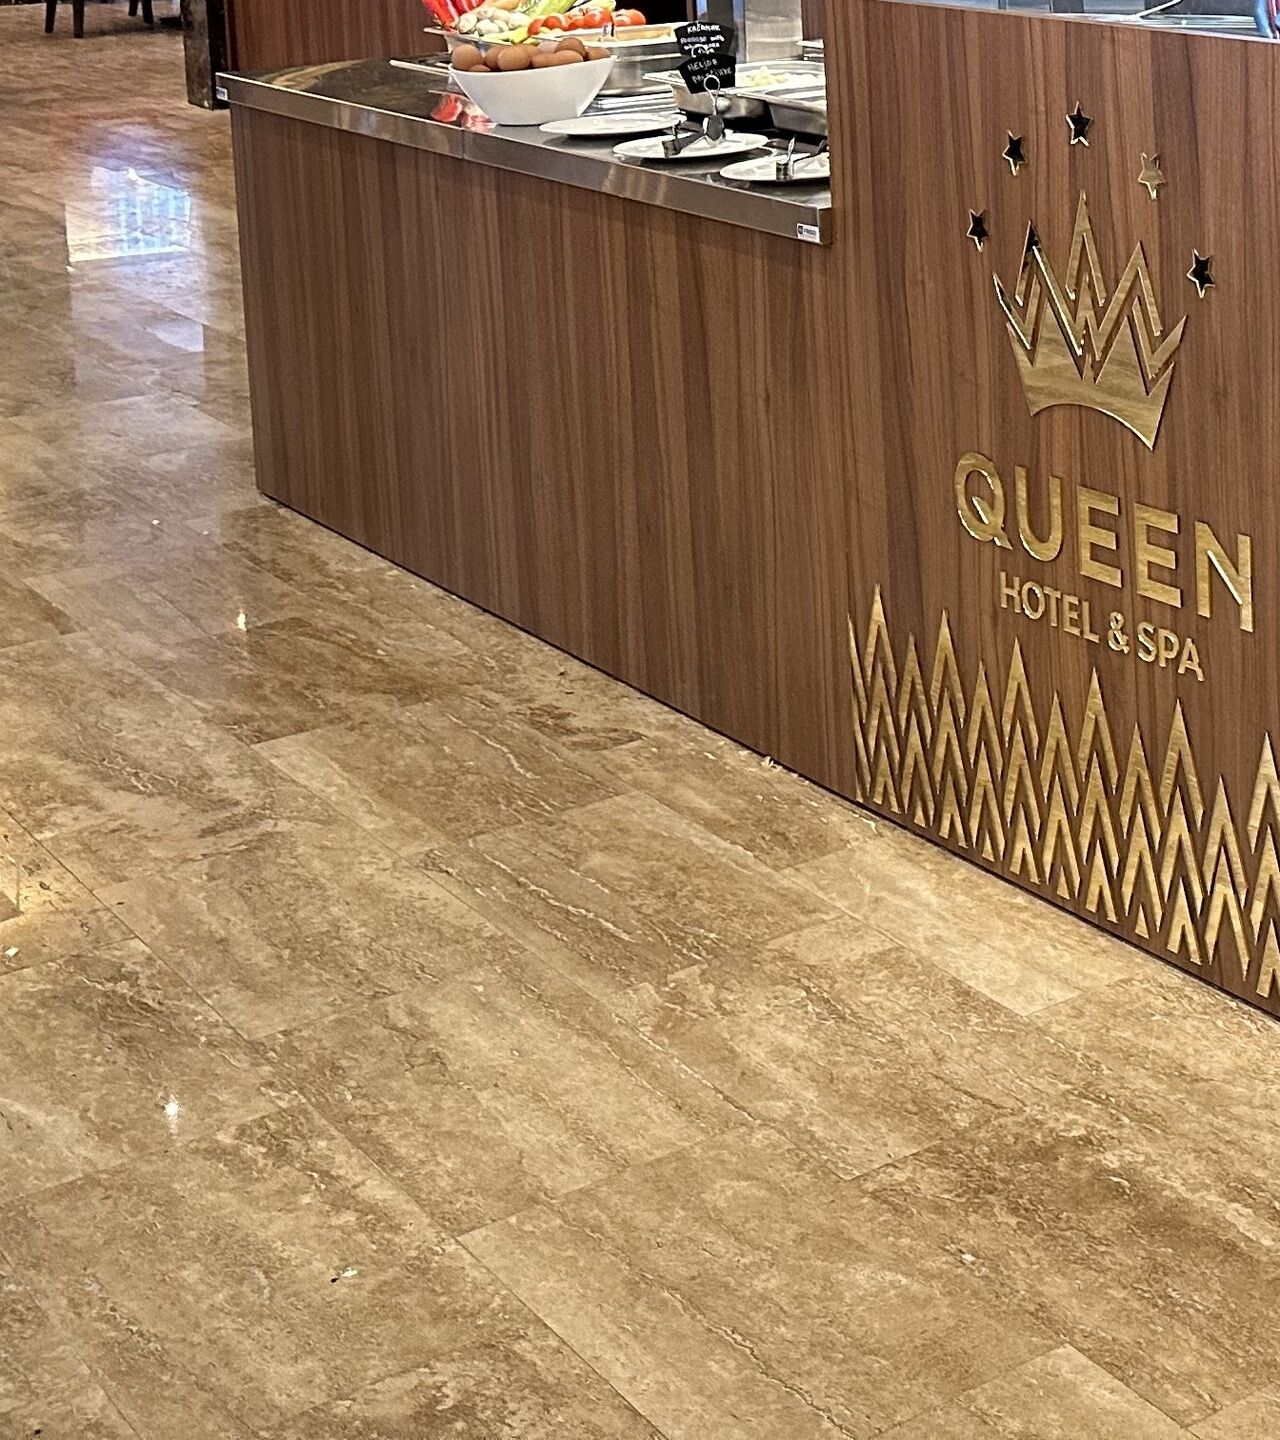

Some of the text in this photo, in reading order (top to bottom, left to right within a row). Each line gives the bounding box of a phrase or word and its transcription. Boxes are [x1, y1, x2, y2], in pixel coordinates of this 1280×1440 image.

[955, 452, 1253, 633] QUEEN
[1000, 570, 1205, 683] HOTEL & SPA
